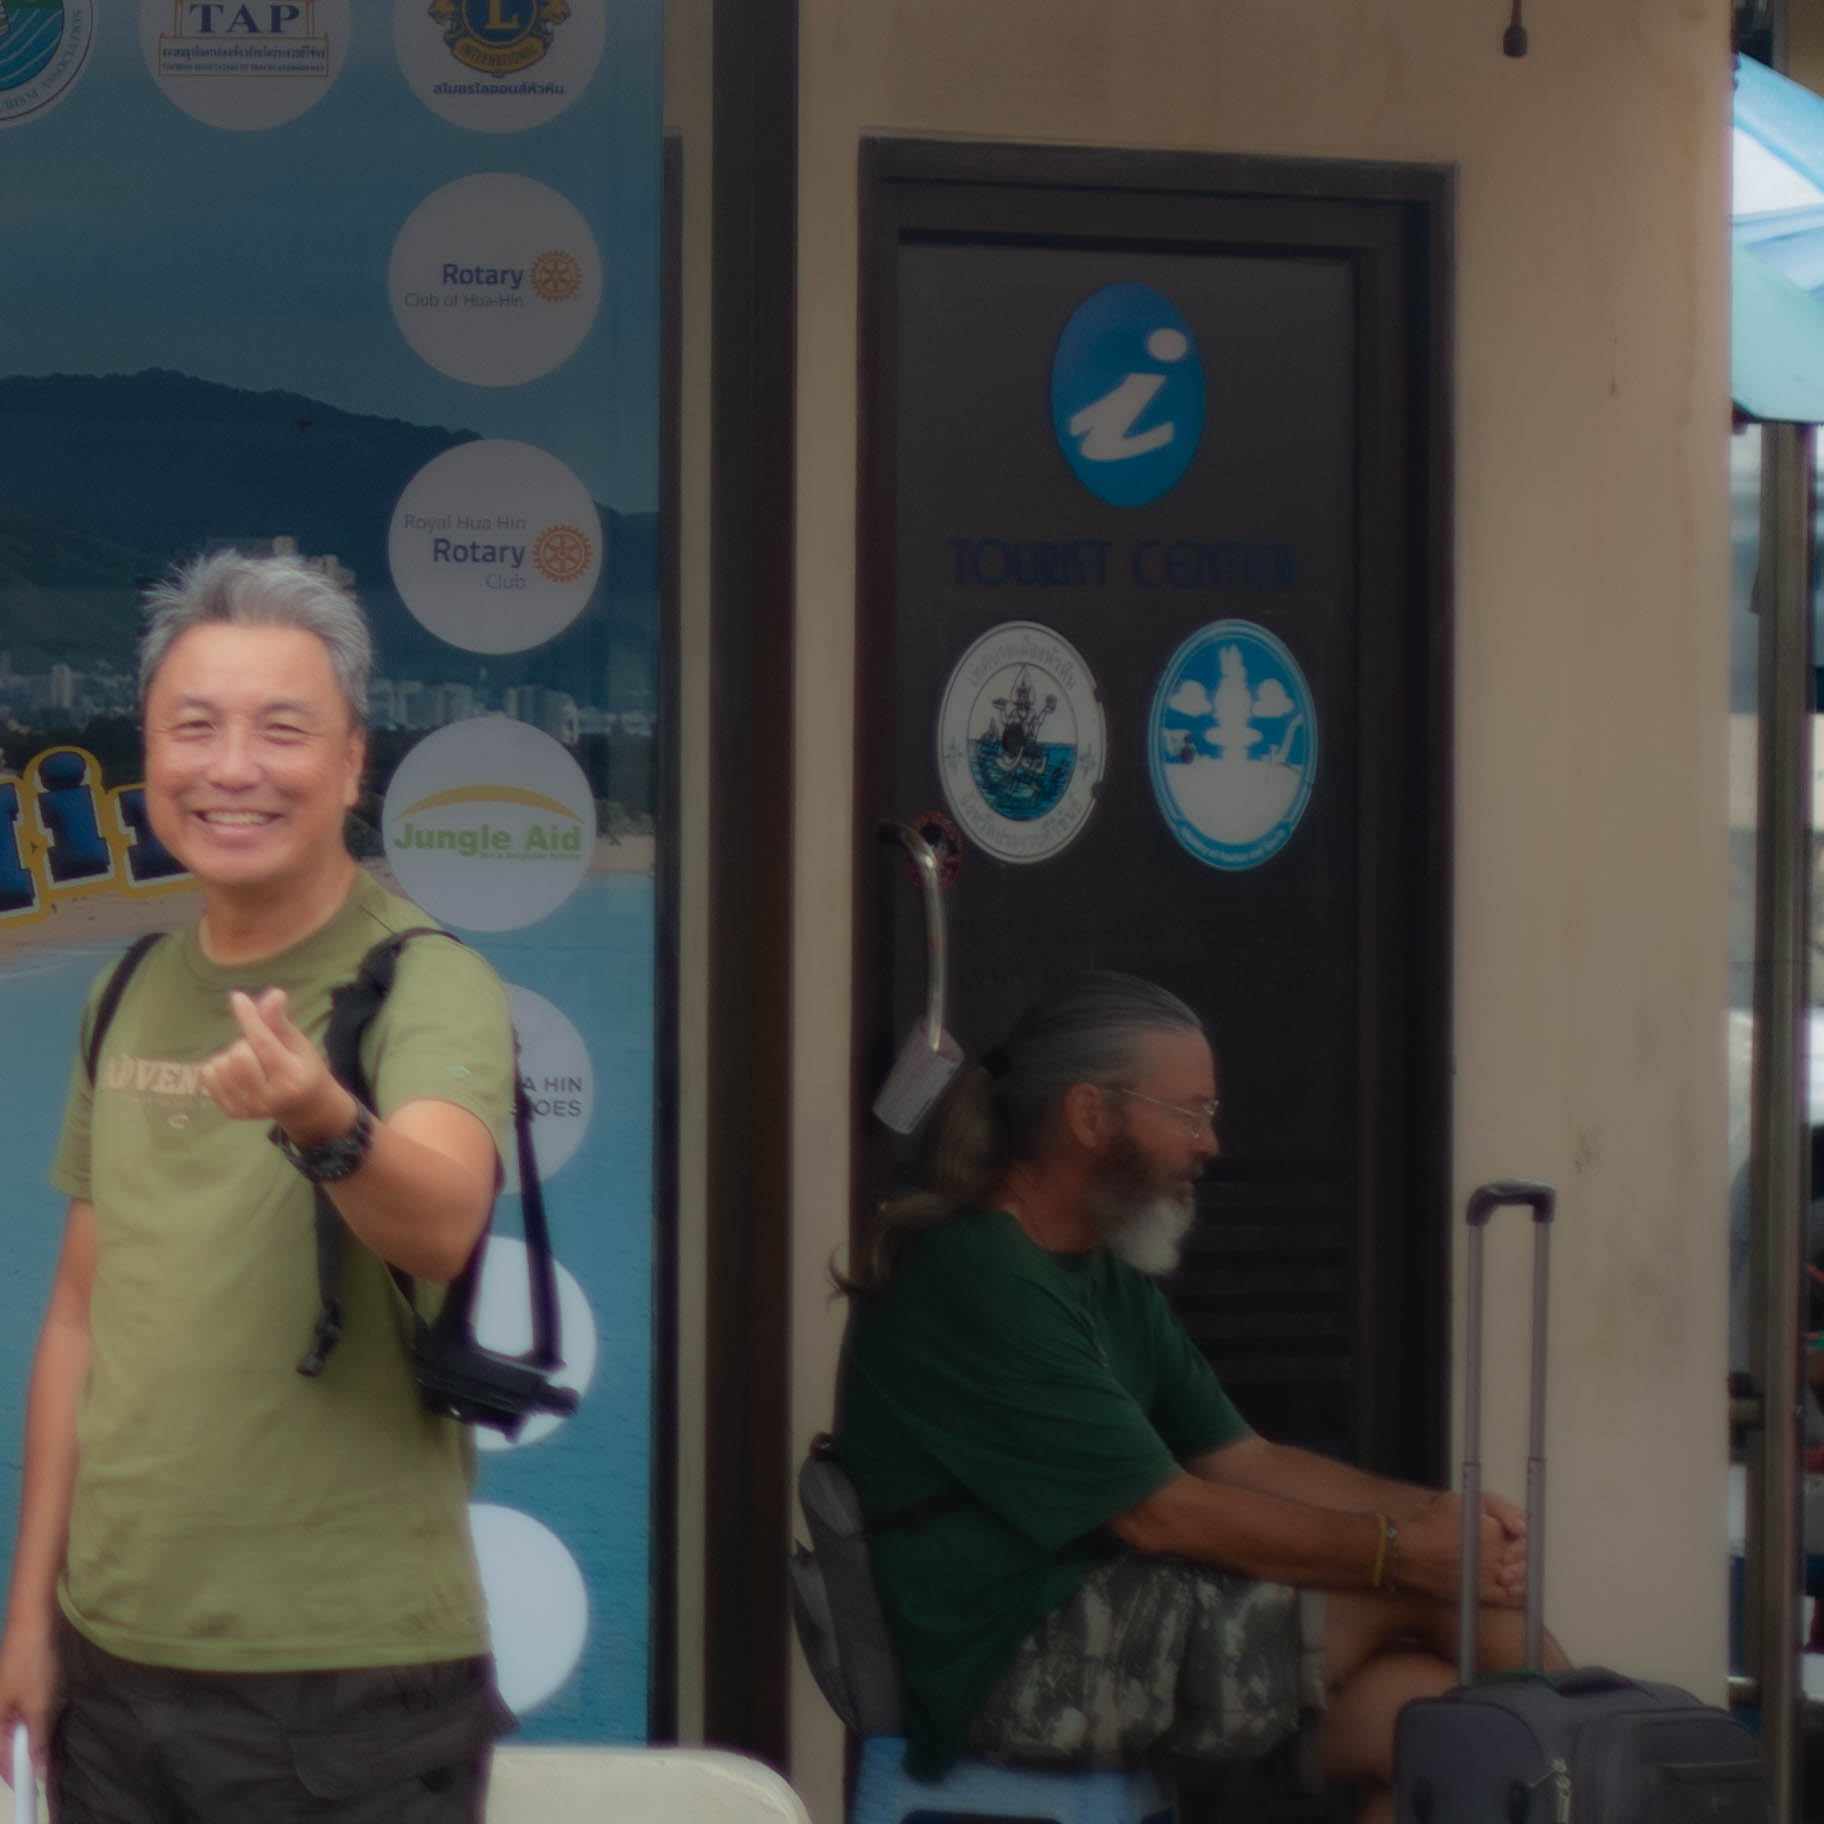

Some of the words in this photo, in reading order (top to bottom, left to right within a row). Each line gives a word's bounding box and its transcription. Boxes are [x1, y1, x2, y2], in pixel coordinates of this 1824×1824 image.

[189, 3, 300, 34] TAP
[443, 263, 524, 290] Rotary
[404, 291, 439, 308] Club
[443, 291, 459, 308] of
[404, 513, 452, 534] Royal
[457, 514, 492, 531] Hua
[496, 514, 528, 529] Hin
[433, 537, 526, 568] Rotary
[485, 573, 528, 590] Club
[392, 823, 513, 857] Jungle
[525, 823, 583, 851] Aid
